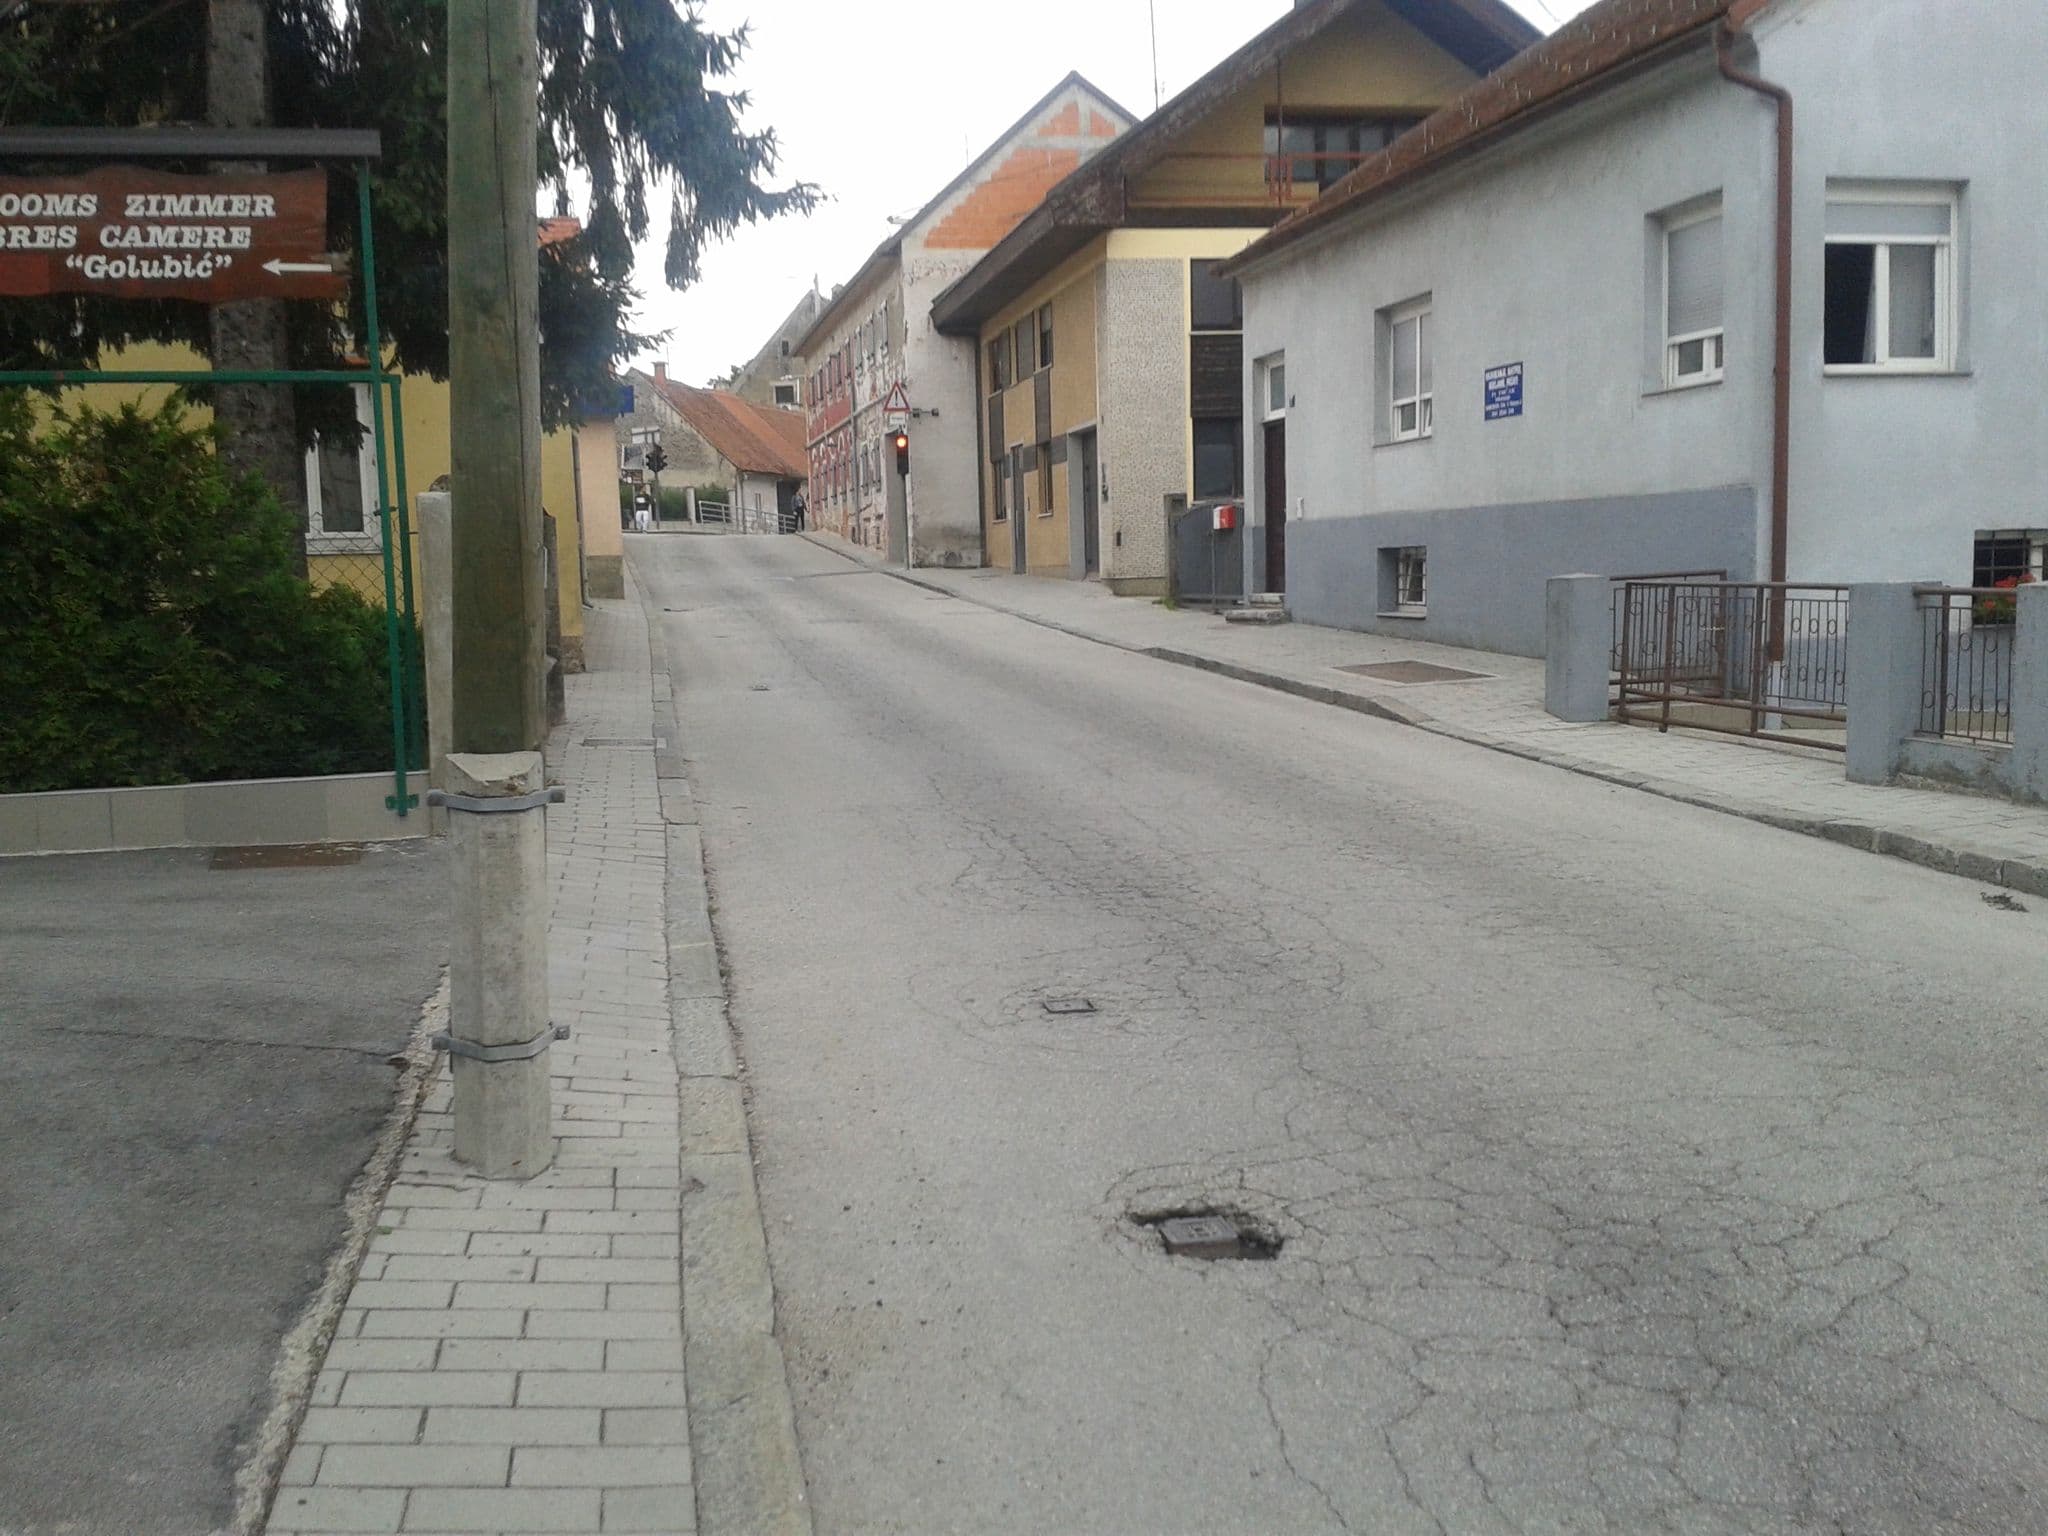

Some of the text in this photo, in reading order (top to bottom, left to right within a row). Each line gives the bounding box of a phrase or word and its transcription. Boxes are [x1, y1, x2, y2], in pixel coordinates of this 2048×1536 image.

[124, 194, 276, 217] ZIMMER
[0, 224, 251, 249] RES CAMERE
[65, 251, 232, 279] “Golubić”
